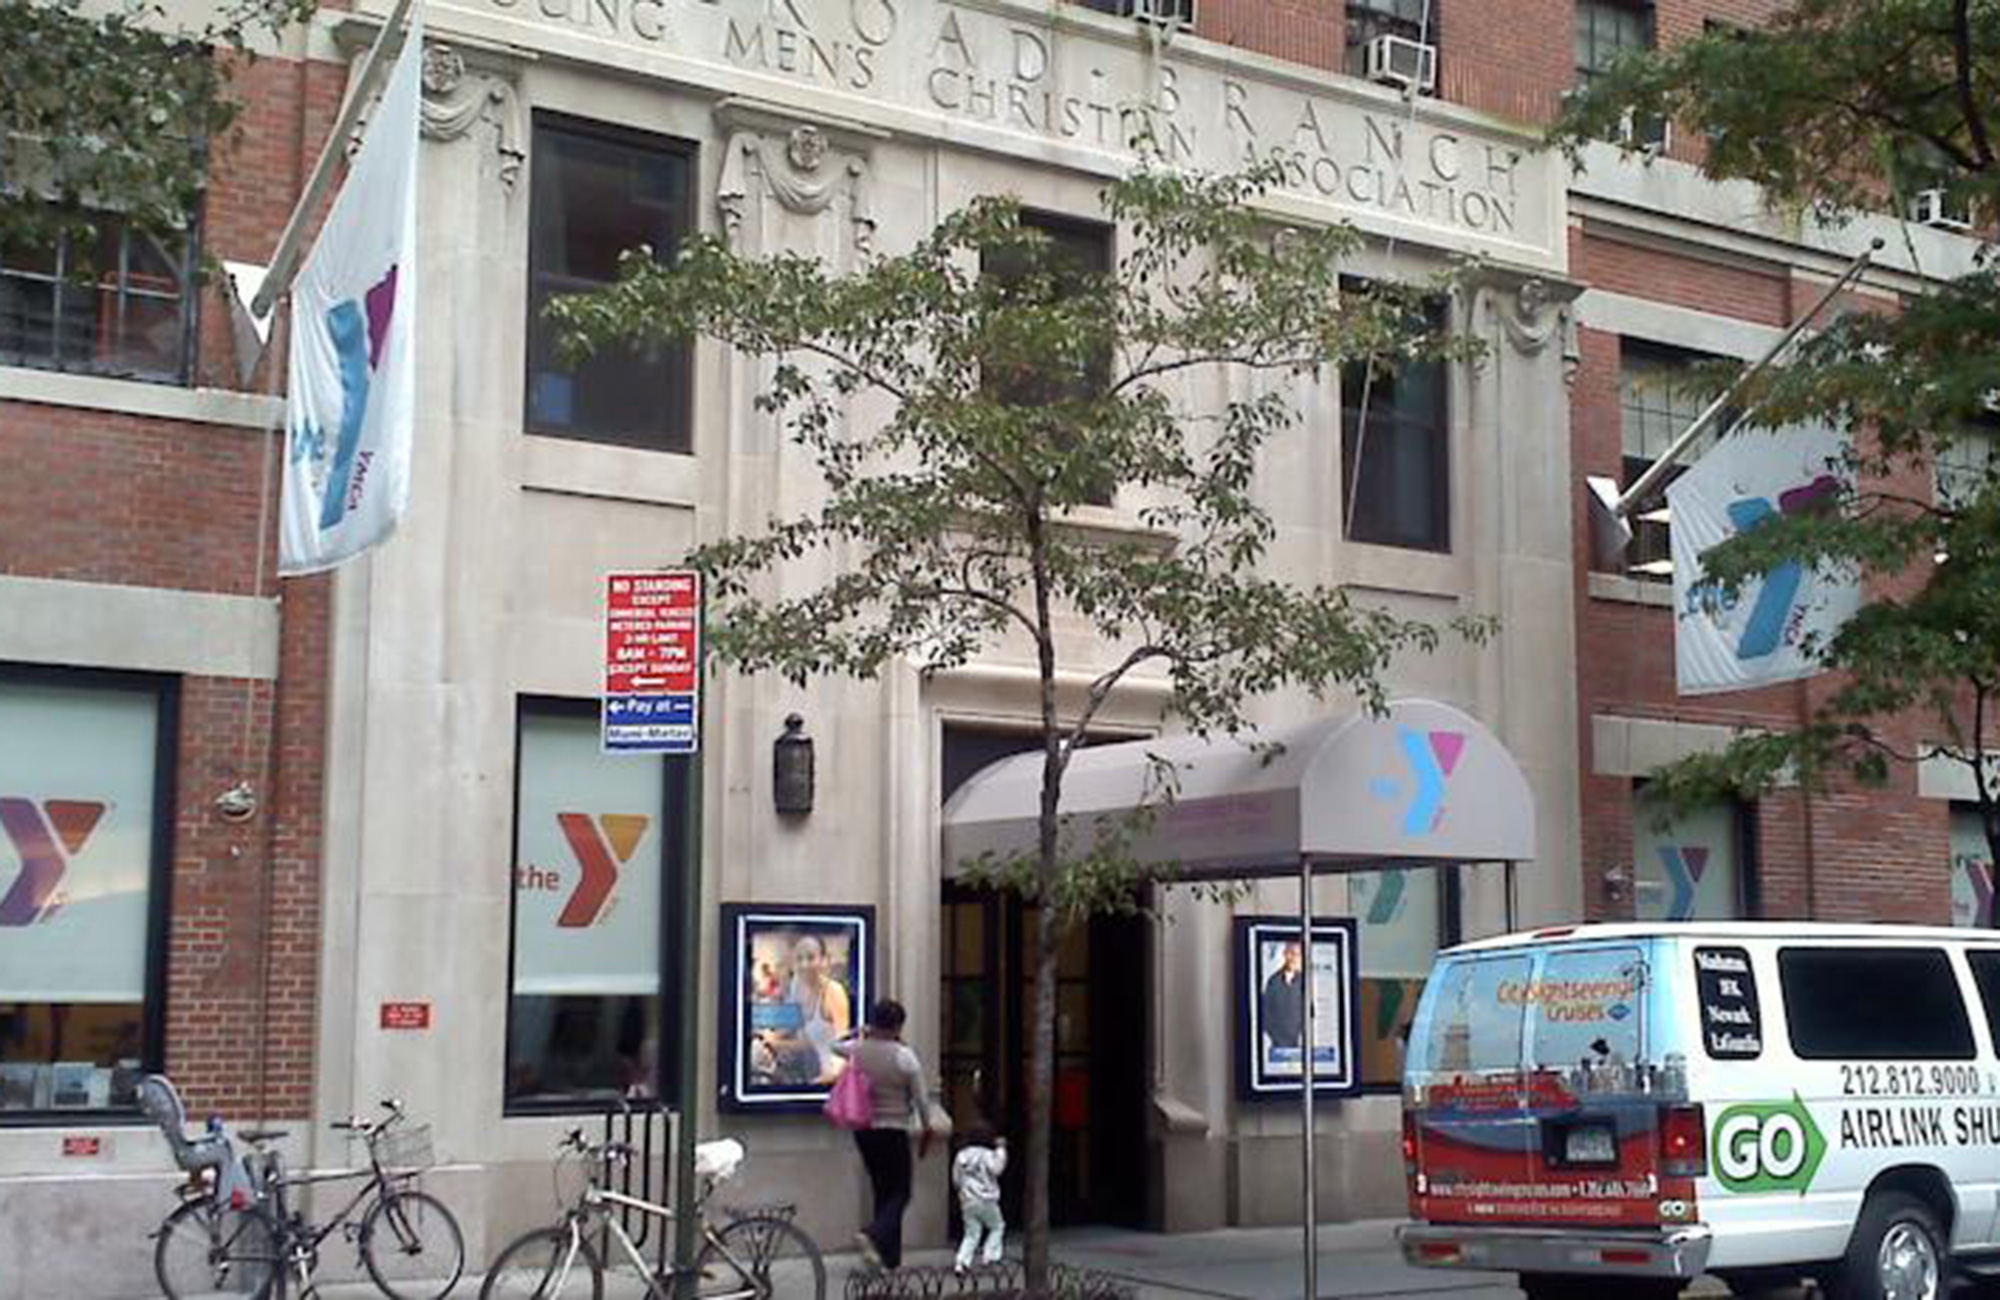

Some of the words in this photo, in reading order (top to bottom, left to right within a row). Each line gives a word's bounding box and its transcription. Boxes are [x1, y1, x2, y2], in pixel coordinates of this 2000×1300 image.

[724, 18, 873, 88] MEN'S
[928, 67, 1196, 161] CHRISTIAN
[612, 580, 630, 593] NO
[633, 579, 692, 593] STANDING
[627, 698, 651, 715] Pay
[655, 699, 671, 712] at
[1841, 1064, 1981, 1095] 212.812.9000
[1717, 1110, 1807, 1182] GO
[1840, 1106, 1948, 1149] AIRLINK
